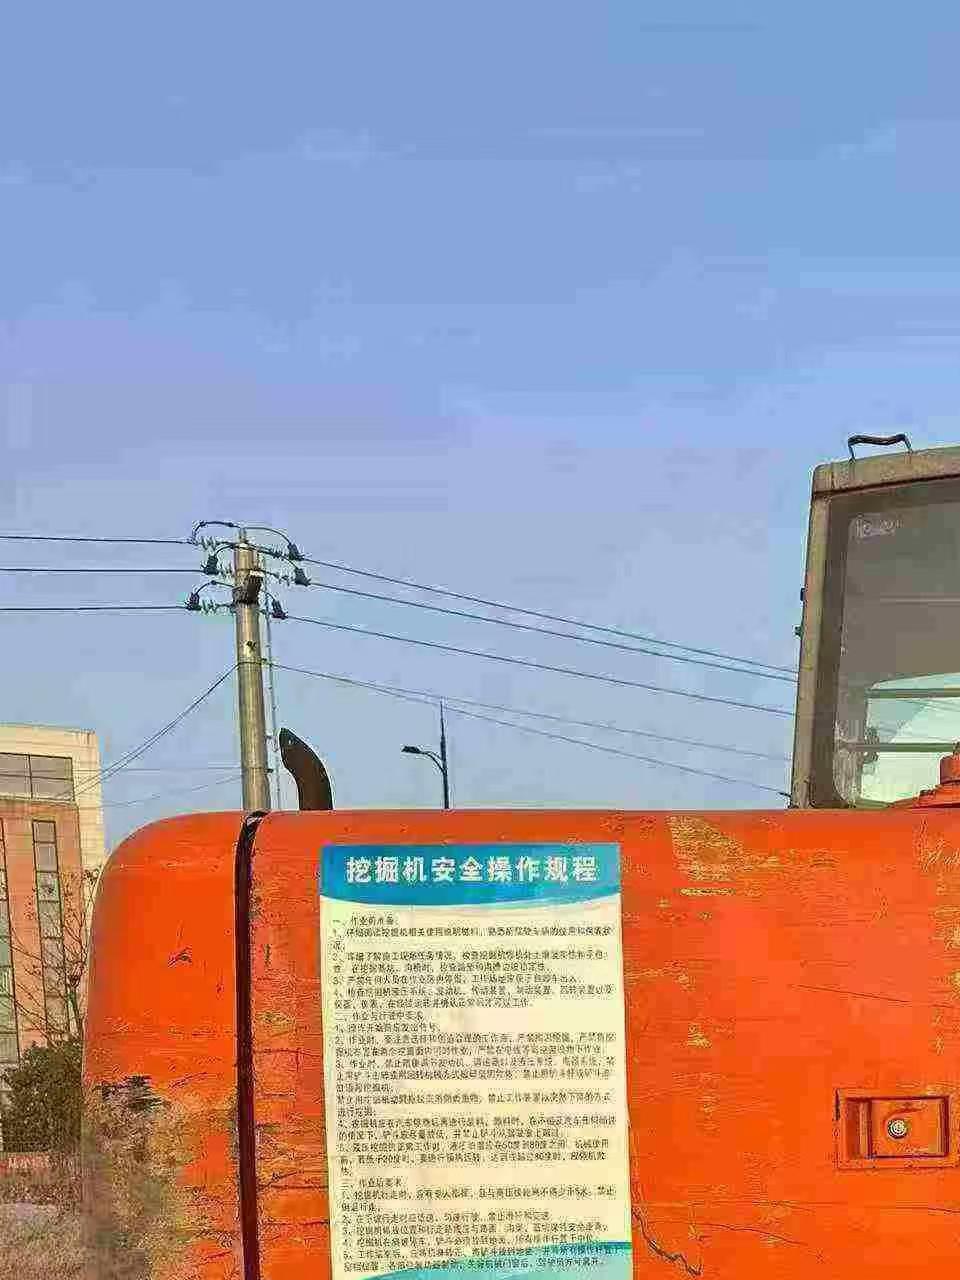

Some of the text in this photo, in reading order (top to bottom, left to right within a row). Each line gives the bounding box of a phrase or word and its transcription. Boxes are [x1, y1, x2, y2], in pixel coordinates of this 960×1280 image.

[345, 856, 600, 883] 挖掘机安全操作规程
